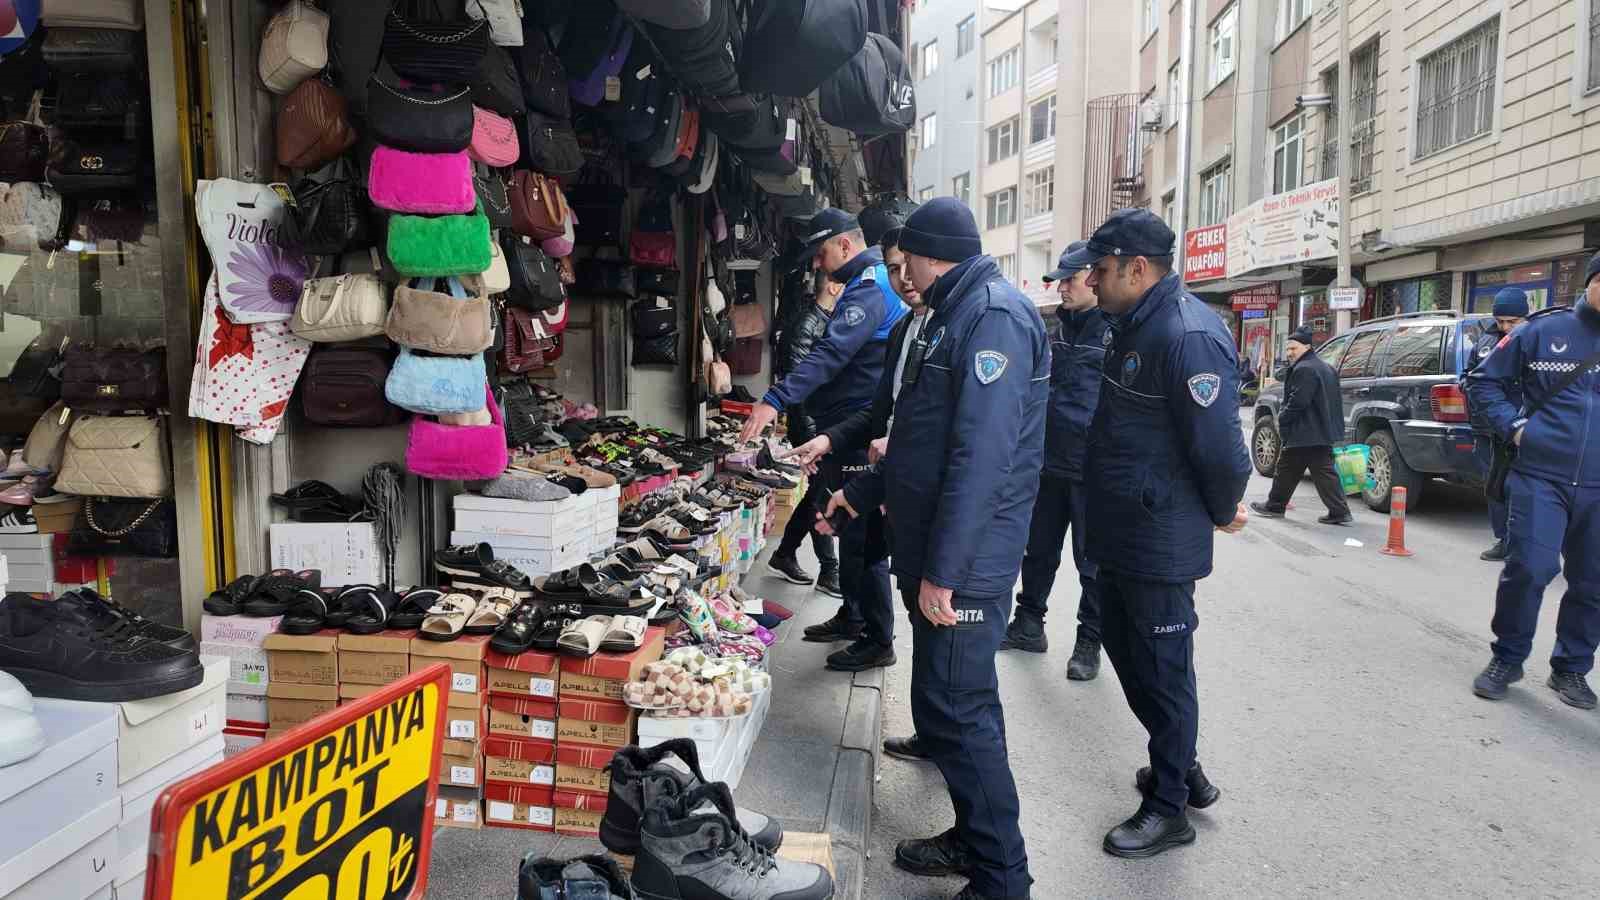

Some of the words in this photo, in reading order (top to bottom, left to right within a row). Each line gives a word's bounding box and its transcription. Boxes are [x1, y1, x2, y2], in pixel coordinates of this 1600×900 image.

[1197, 228, 1225, 248] ERKEK
[1186, 248, 1225, 272] KUAFÖRÜ
[1153, 623, 1187, 634] ZABITA
[560, 683, 600, 693] APELLA
[490, 723, 529, 733] APELLA
[559, 729, 598, 739] APELLA
[190, 687, 425, 867] KAMPANYA
[489, 770, 528, 779] APELLA
[556, 777, 595, 786] APELLA
[227, 758, 390, 900] BOT
[556, 819, 596, 829] APELLA
